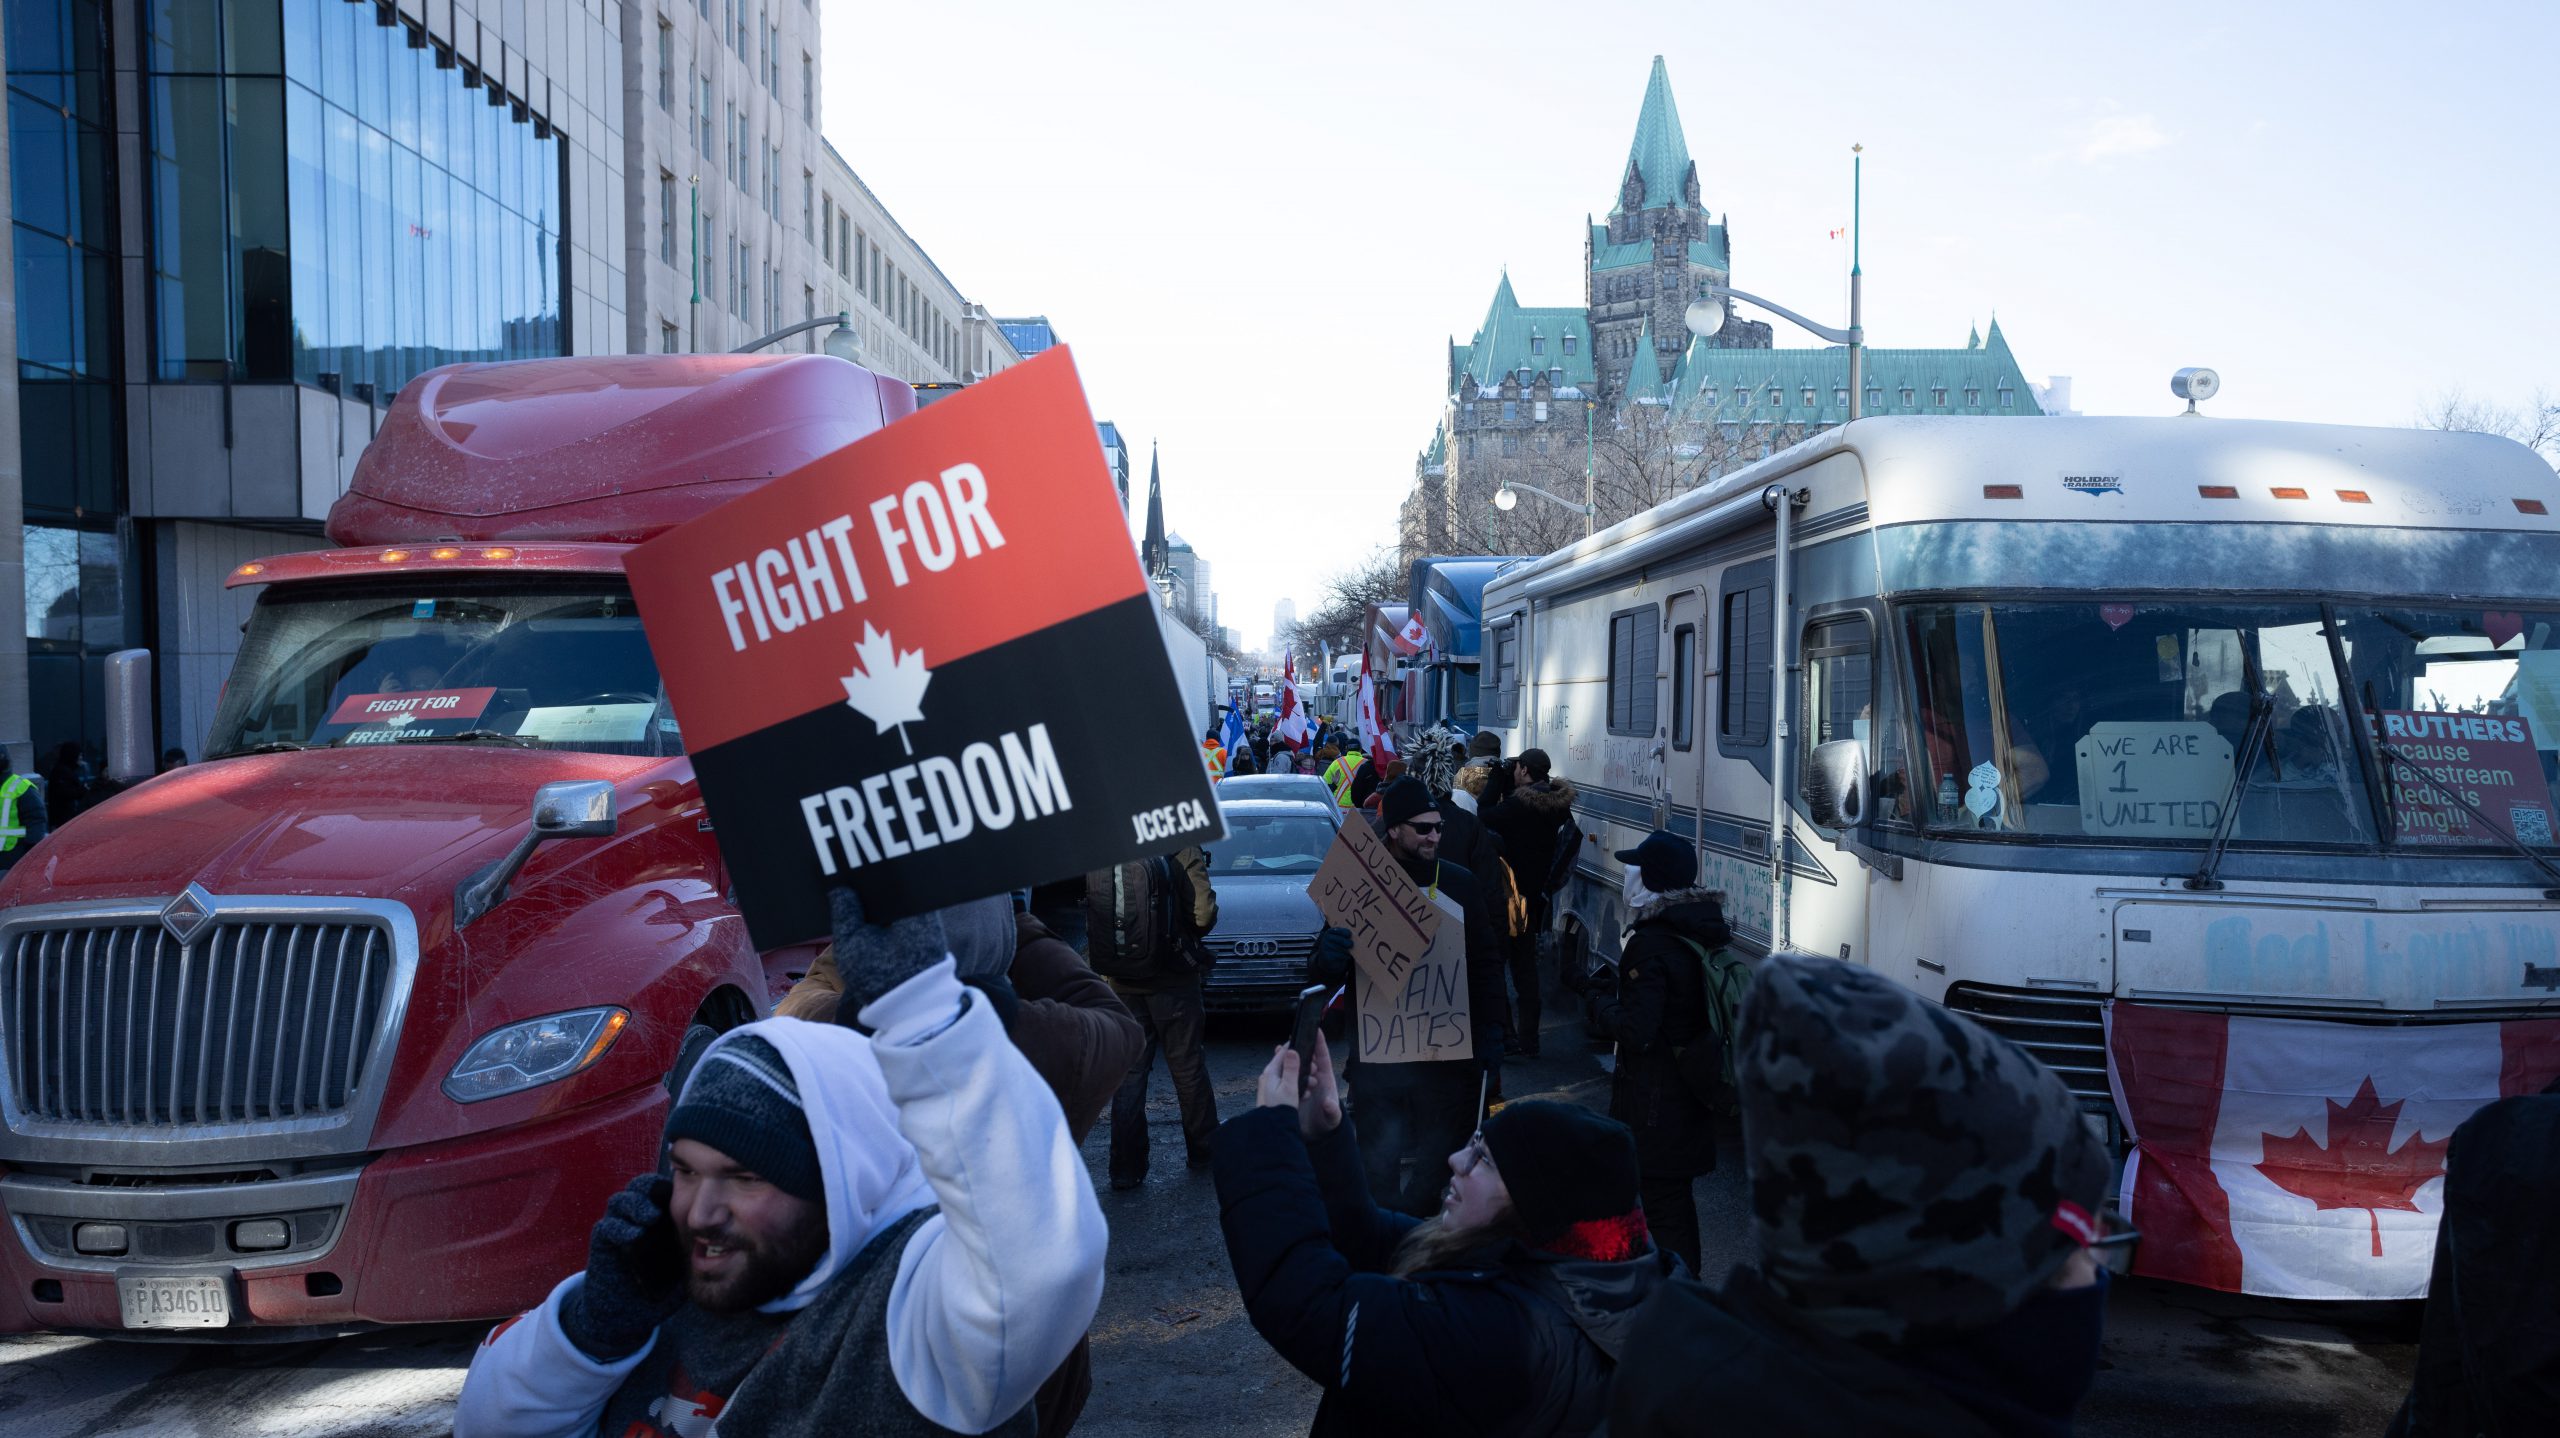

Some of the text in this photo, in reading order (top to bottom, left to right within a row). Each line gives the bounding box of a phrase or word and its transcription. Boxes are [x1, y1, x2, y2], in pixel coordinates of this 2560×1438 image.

[711, 462, 1006, 652] FIGHT FOR
[365, 695, 460, 713] FIGHT FOR
[345, 729, 434, 744] FREEDOM
[2098, 735, 2200, 757] WE ARE
[2370, 738, 2470, 761] cause
[2108, 760, 2139, 793] 1
[800, 722, 1073, 876] FREEDOM
[2099, 800, 2221, 829] UNITED
[2460, 786, 2481, 807] is
[1131, 798, 1210, 844] JCCF.CA
[1354, 831, 1433, 925] JUSTIN
[1351, 877, 1383, 916] IN-
[1325, 876, 1411, 981] JUSTICE
[1362, 1012, 1467, 1056] DATES
